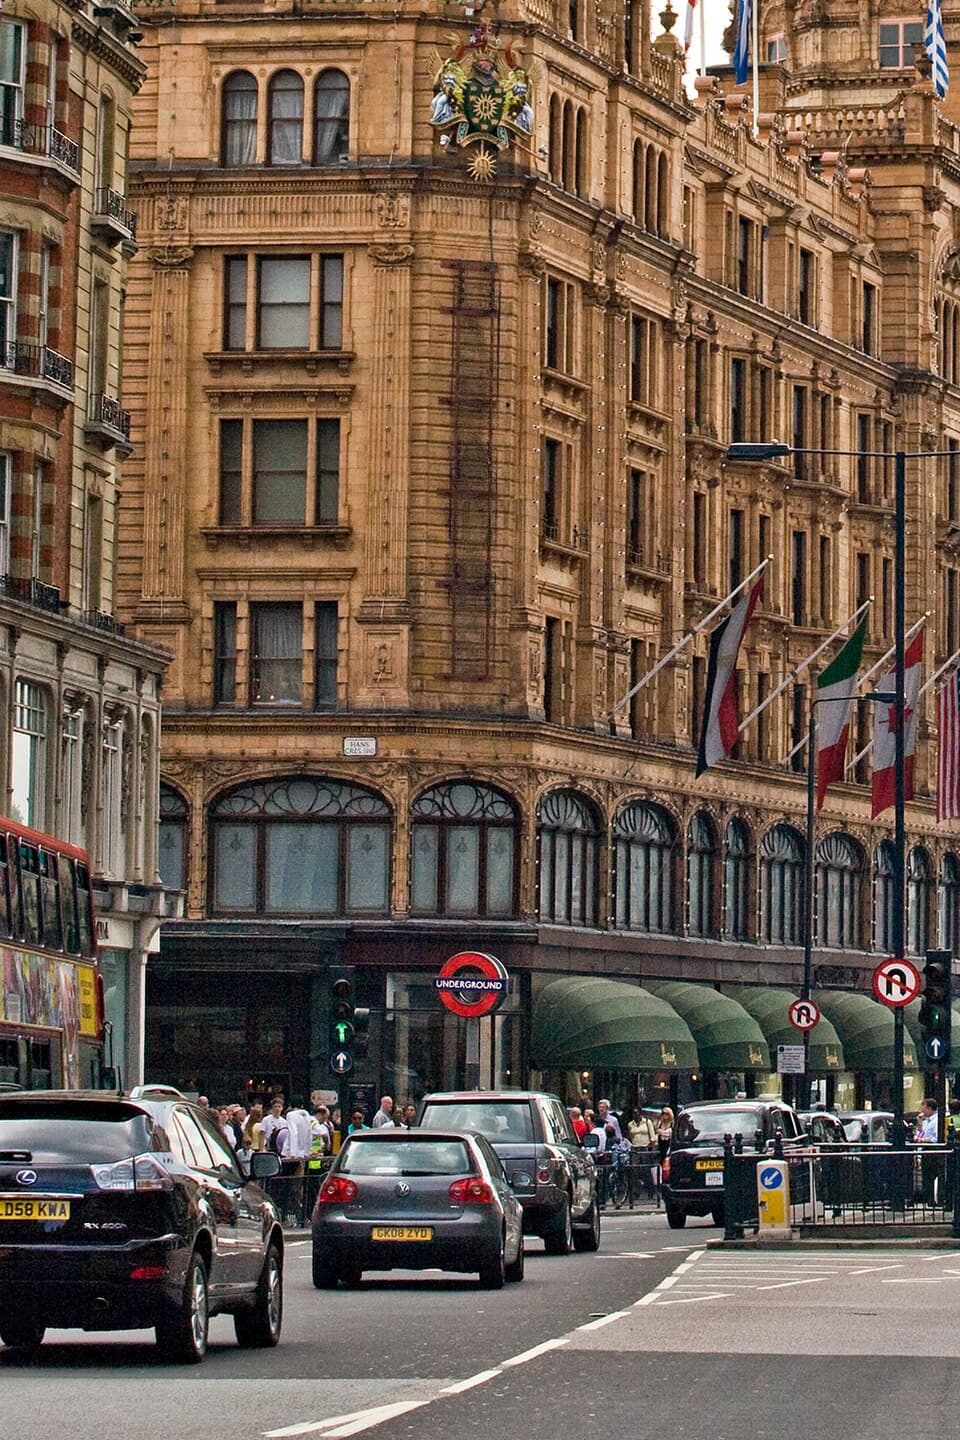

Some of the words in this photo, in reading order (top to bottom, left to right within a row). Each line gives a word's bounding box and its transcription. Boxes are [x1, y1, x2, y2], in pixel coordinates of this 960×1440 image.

[435, 979, 503, 990] UNDERGROUND
[0, 1202, 33, 1216] D58
[38, 1203, 67, 1217] KWA
[84, 1222, 99, 1230] RX
[376, 1229, 404, 1238] GK08
